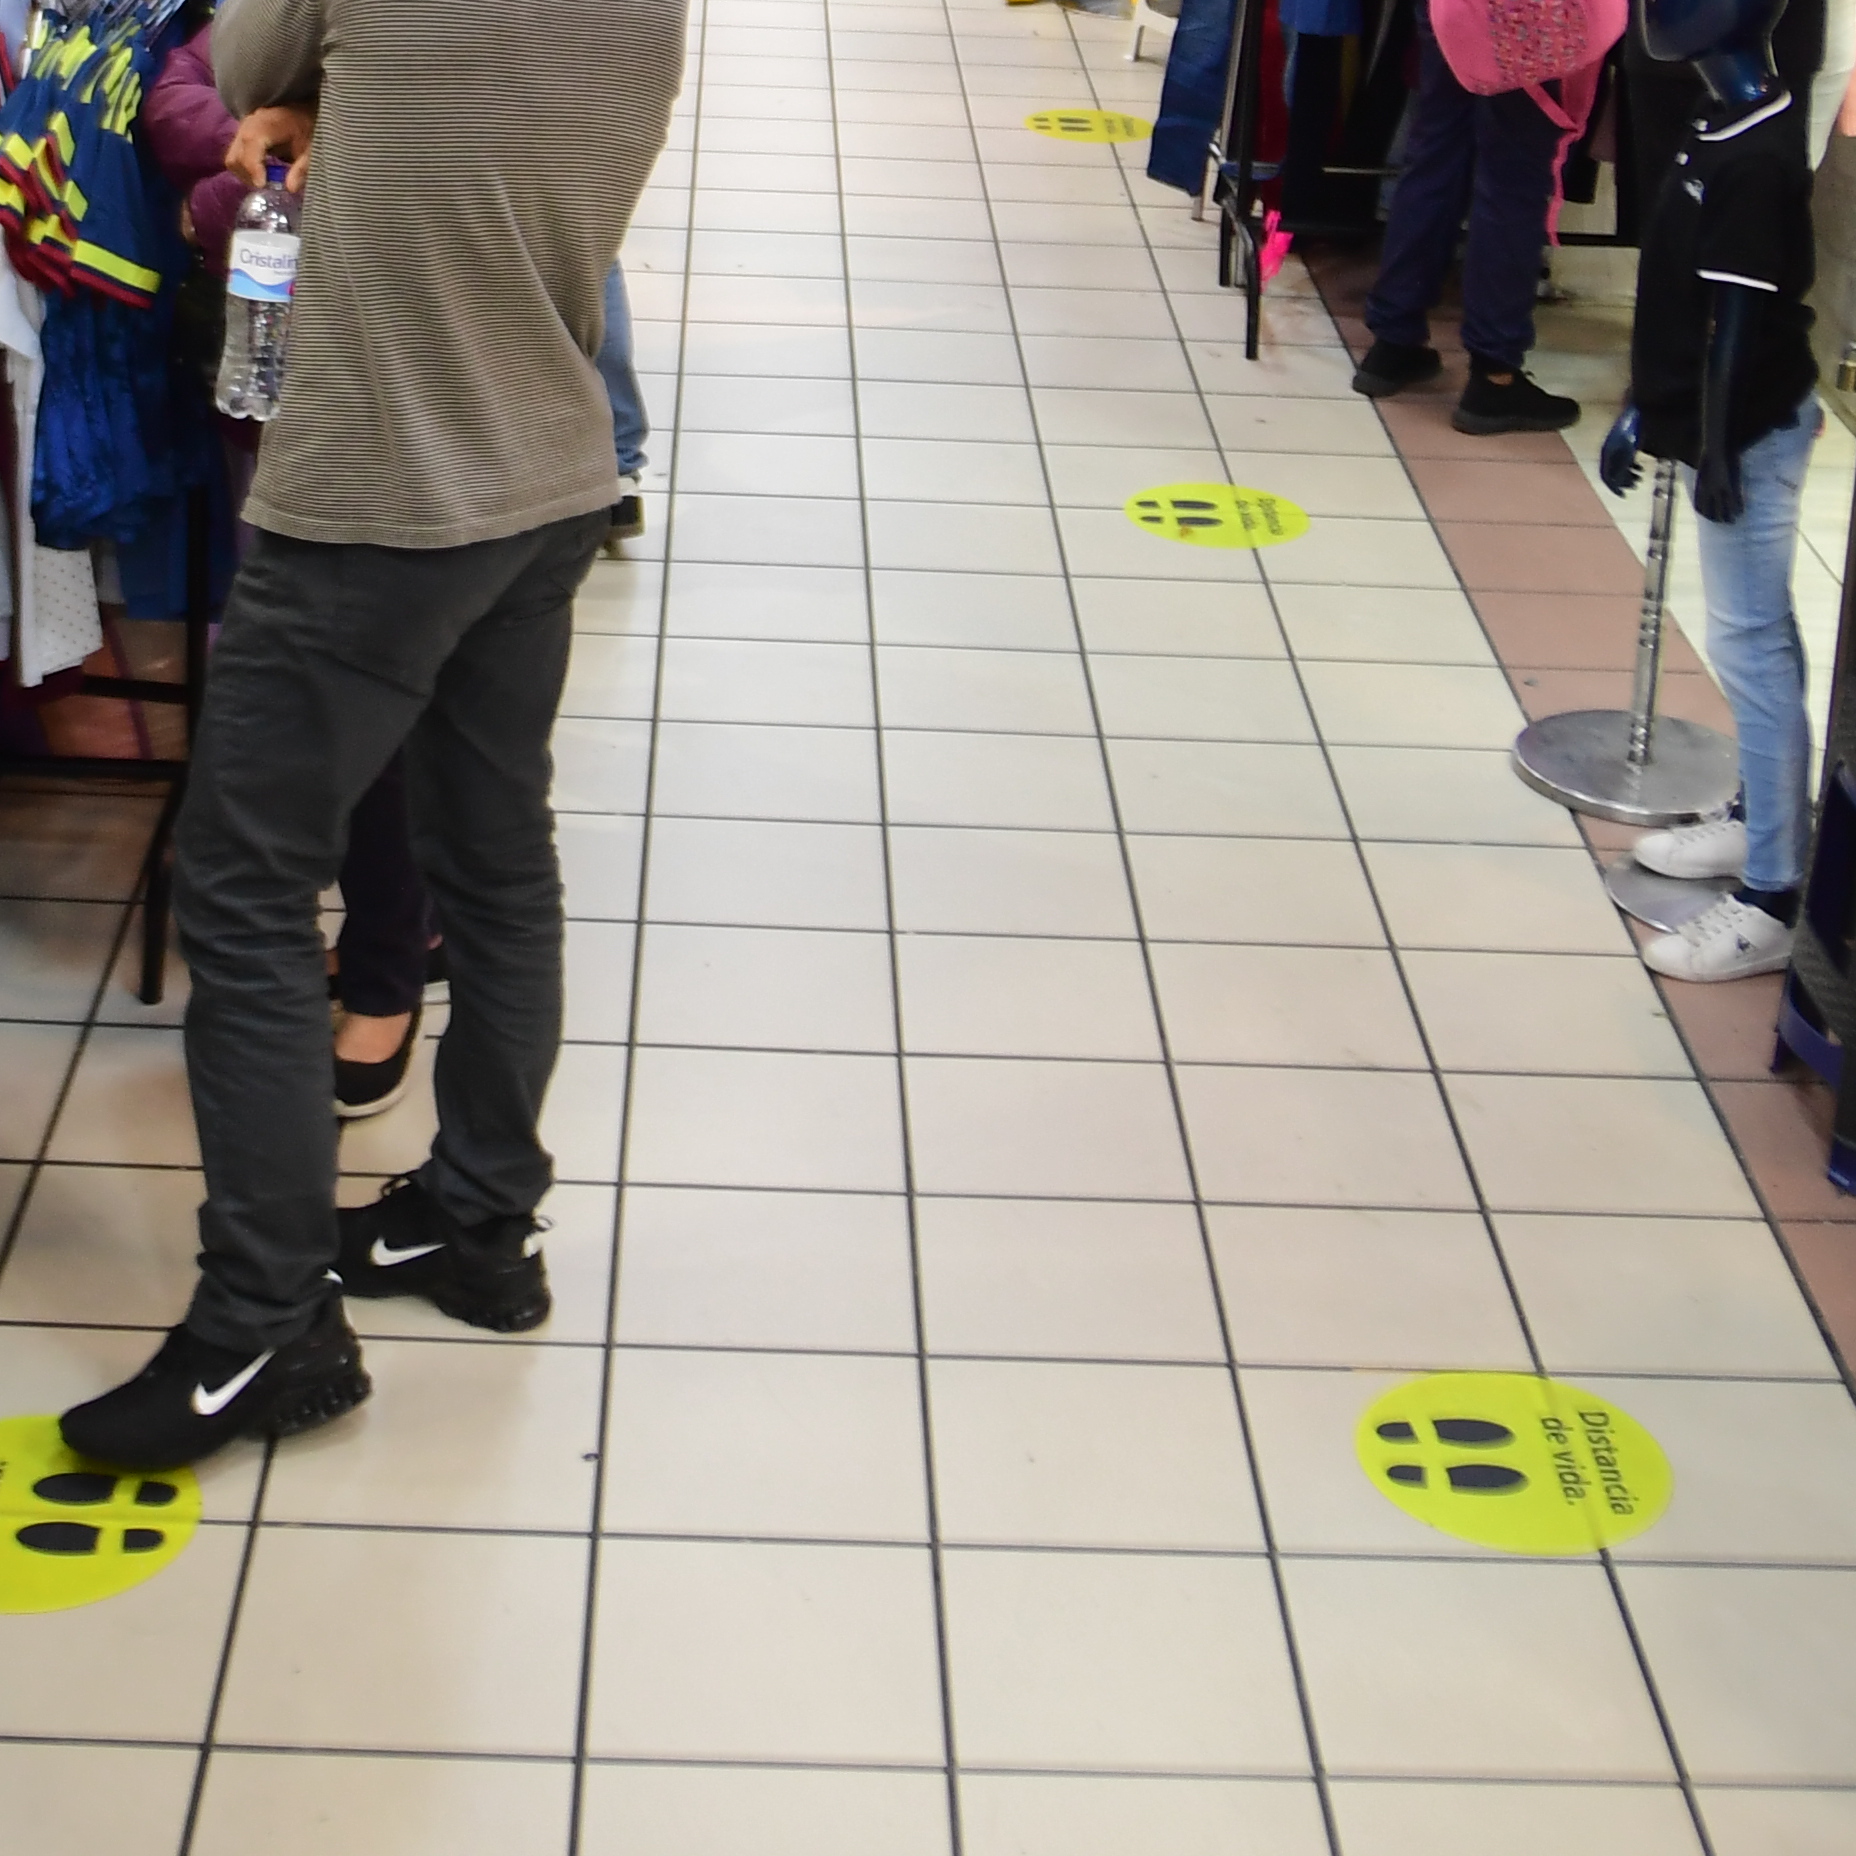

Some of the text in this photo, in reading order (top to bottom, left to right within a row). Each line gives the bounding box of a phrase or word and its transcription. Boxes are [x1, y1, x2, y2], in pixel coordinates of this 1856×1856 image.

[239, 248, 299, 269] Cristalin
[1540, 1415, 1591, 1507] de vida.
[1577, 1408, 1641, 1517] Distancia
